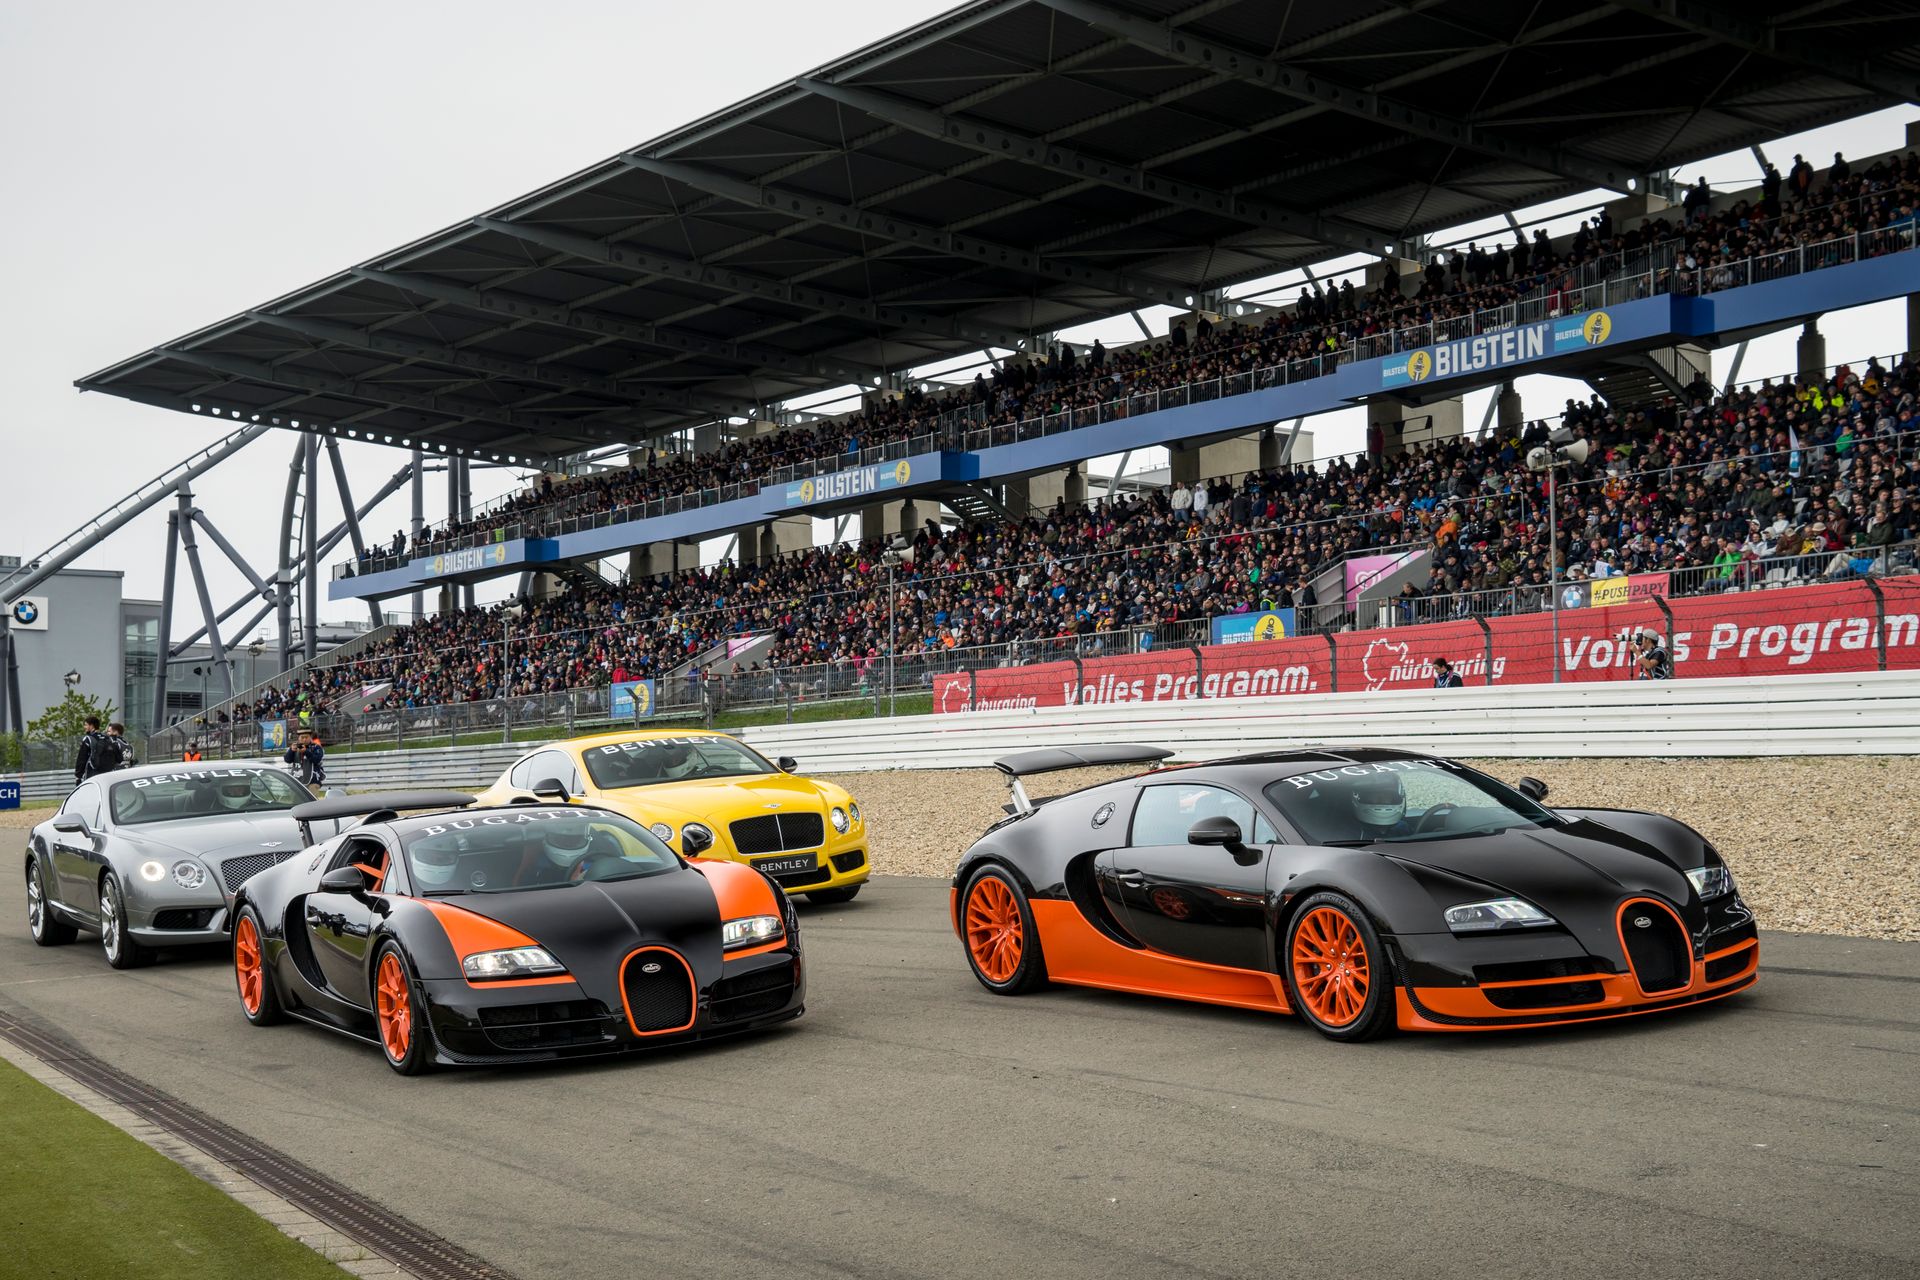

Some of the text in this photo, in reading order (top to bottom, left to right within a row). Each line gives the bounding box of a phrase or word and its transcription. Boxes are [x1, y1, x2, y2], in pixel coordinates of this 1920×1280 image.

[1436, 325, 1544, 377] BILSTEIN
[816, 467, 875, 501] BILSTEIN
[444, 549, 483, 573] BILSTEIN
[1594, 582, 1667, 601] #PUSHPAPY
[1563, 614, 1919, 671] Vols Program
[1389, 653, 1506, 681] nürbgrig
[1064, 666, 1318, 706] Volles Programm.
[600, 736, 719, 755] BENTLEY
[131, 769, 264, 789] BENTLEY
[1283, 760, 1462, 790] BUGATTI
[421, 810, 612, 837] BUGATTI
[760, 859, 809, 872] BENTLEY
